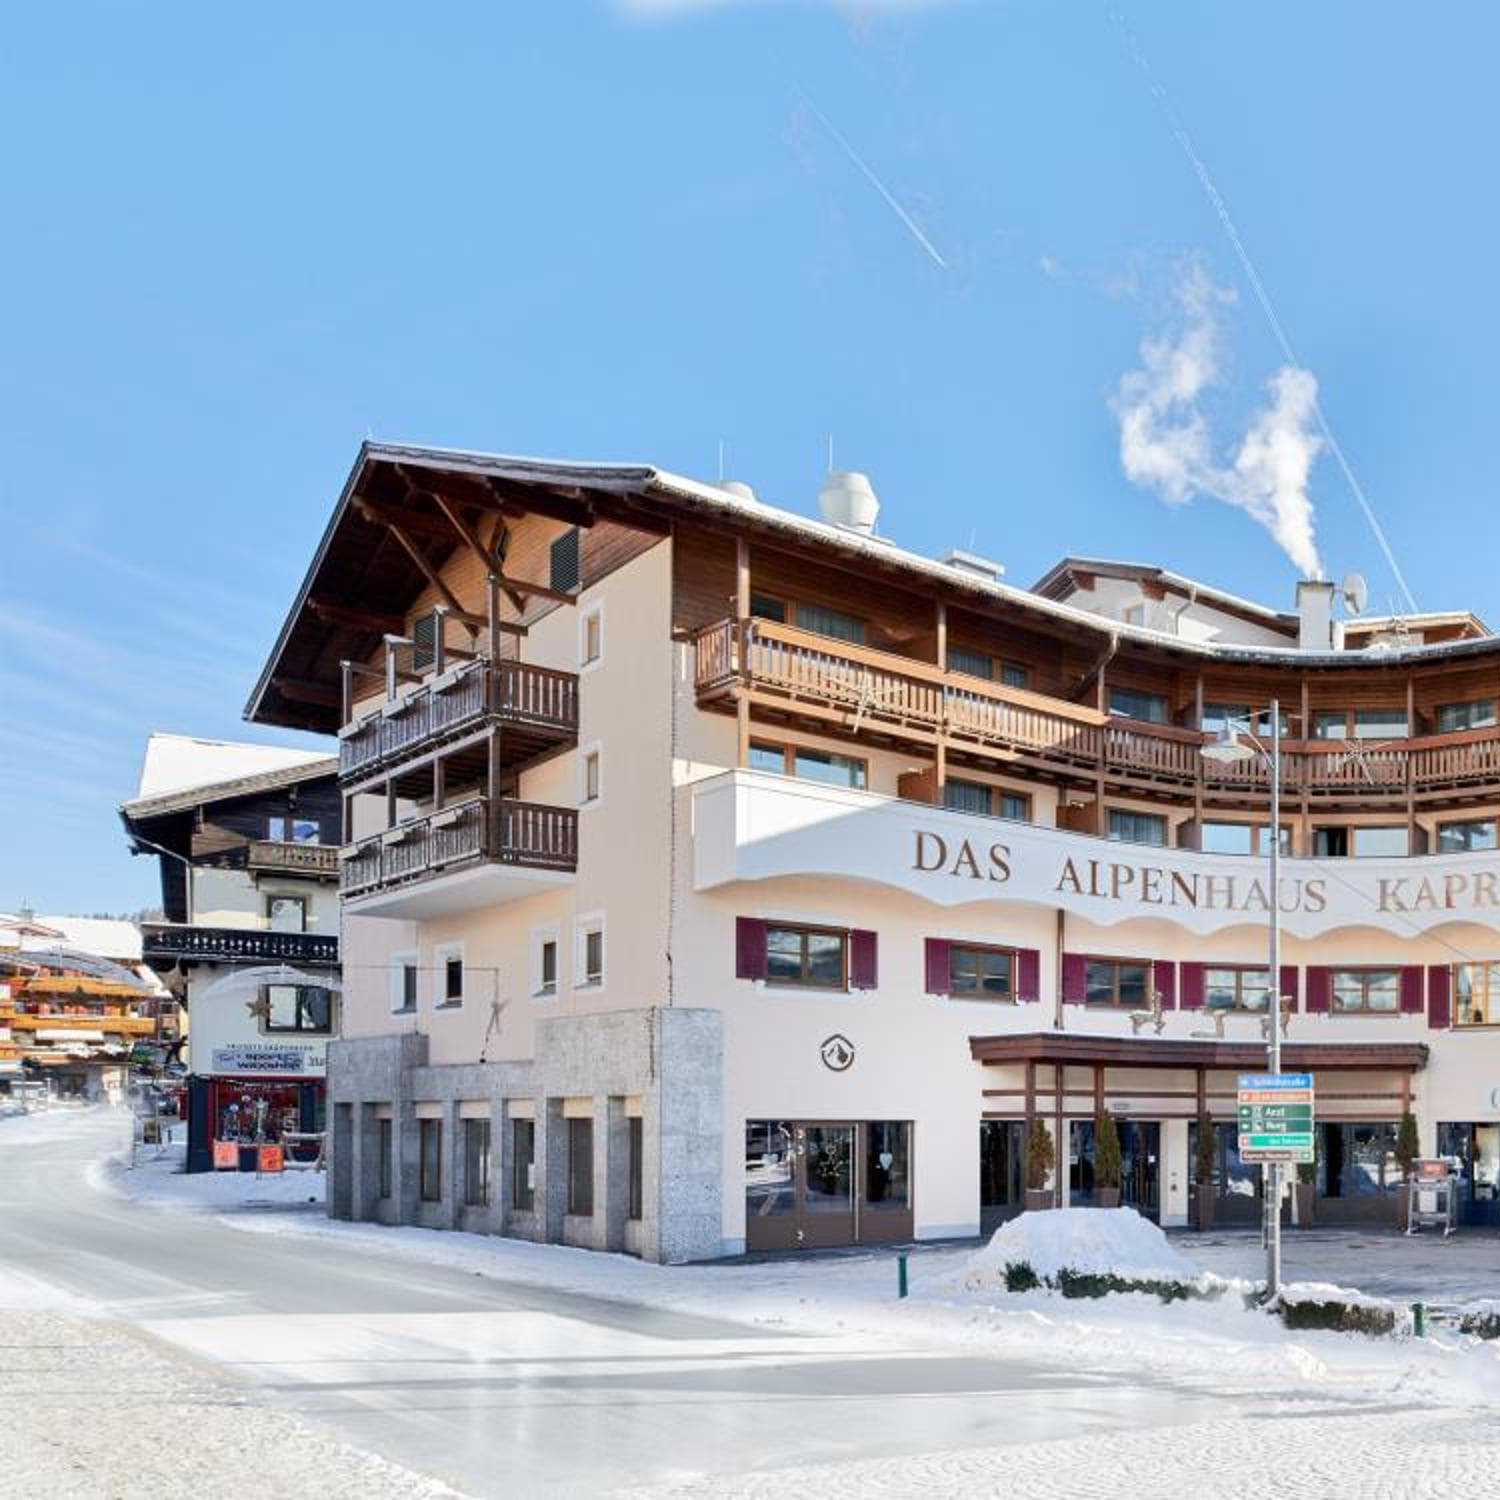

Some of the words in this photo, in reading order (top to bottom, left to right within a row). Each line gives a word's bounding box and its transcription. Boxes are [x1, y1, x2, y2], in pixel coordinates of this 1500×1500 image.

[911, 830, 1011, 882] DAS
[1055, 856, 1327, 913] ALPENHAUS
[1265, 1107, 1285, 1118] Arzt
